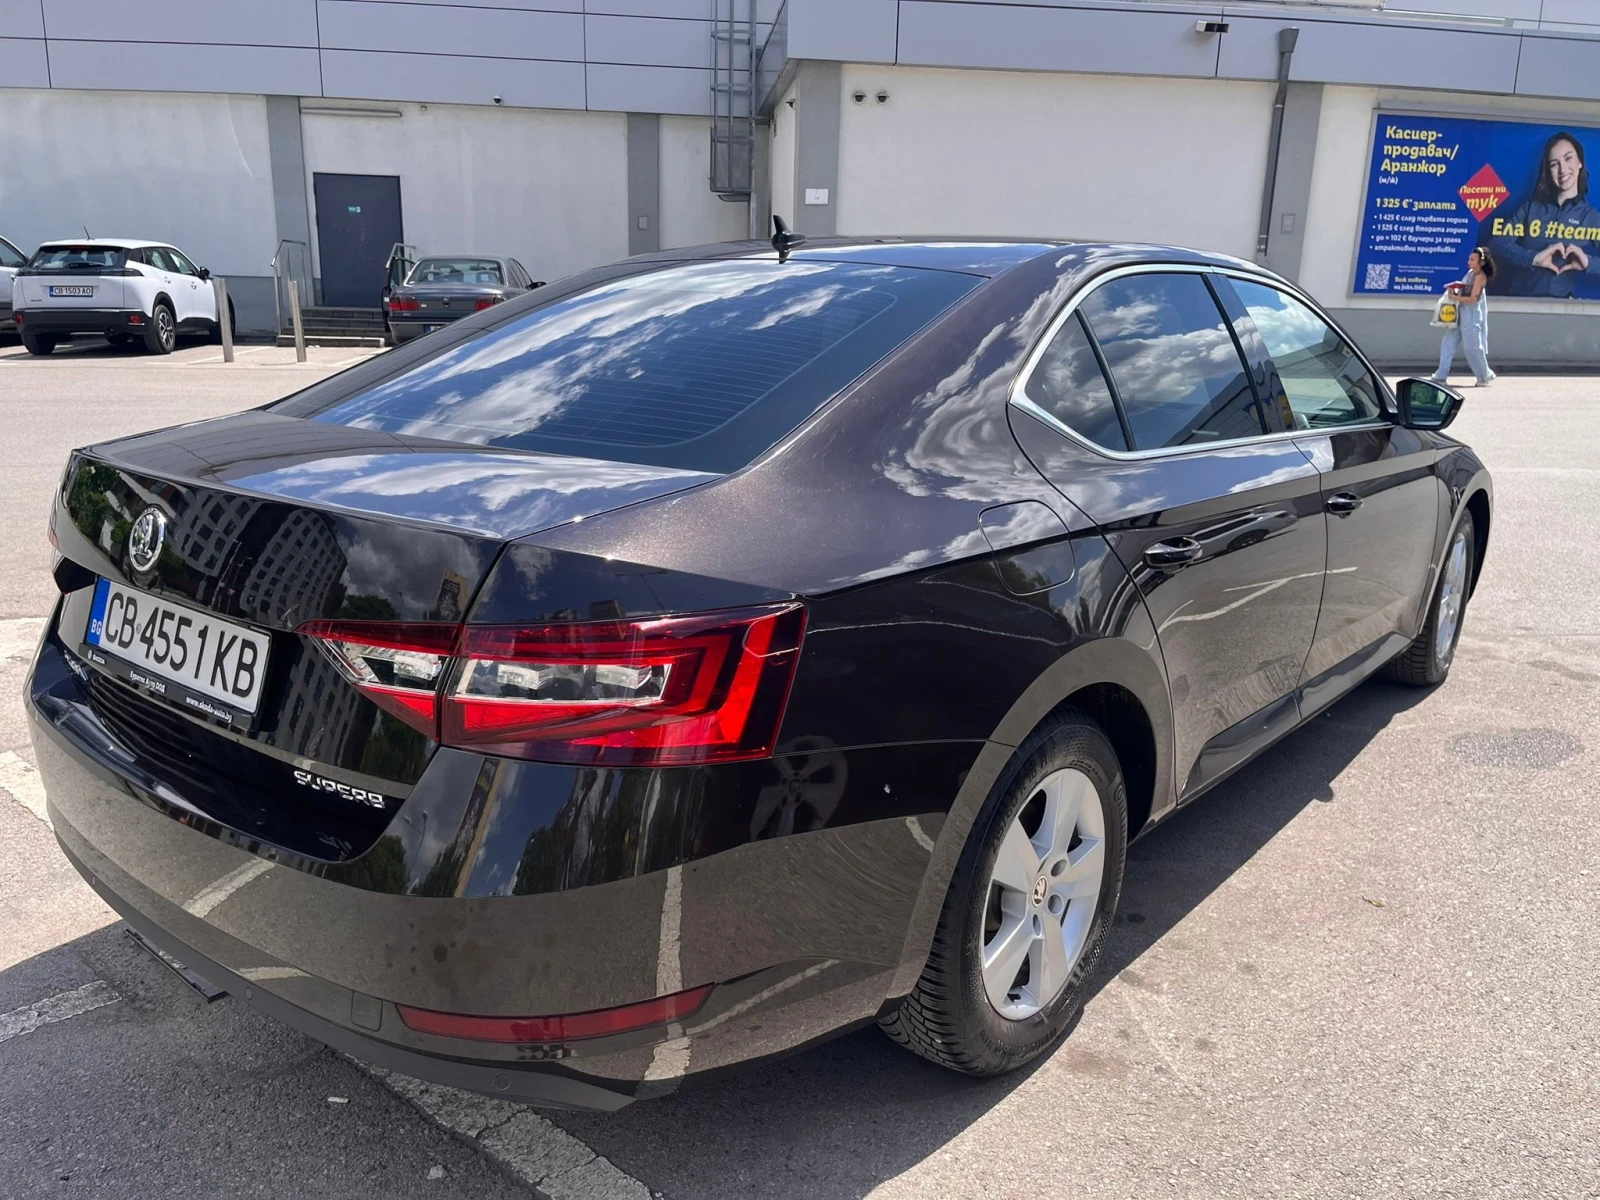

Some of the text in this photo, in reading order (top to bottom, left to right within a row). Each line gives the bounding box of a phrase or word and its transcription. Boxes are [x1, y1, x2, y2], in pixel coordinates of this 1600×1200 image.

[1386, 125, 1443, 144] Касиер-
[1383, 144, 1459, 161] продавач/
[1380, 158, 1447, 177] Аранжор
[1378, 176, 1399, 185] (м/ж)
[1460, 185, 1494, 194] Посети
[1412, 201, 1456, 211] заплата
[1466, 194, 1499, 212] тук
[1401, 215, 1416, 223] след
[1417, 215, 1445, 223] първата
[1446, 217, 1468, 225] година
[1492, 217, 1525, 237] Ела
[1529, 219, 1542, 238] в
[1399, 225, 1414, 233] след
[1415, 225, 1445, 233] втората
[1408, 235, 1434, 243] ваучери
[1374, 244, 1456, 254] атрактивни придобивки
[91, 618, 103, 636] BG
[185, 696, 233, 724] www.skoda-auto.bg
[293, 770, 386, 809] SUPERB
